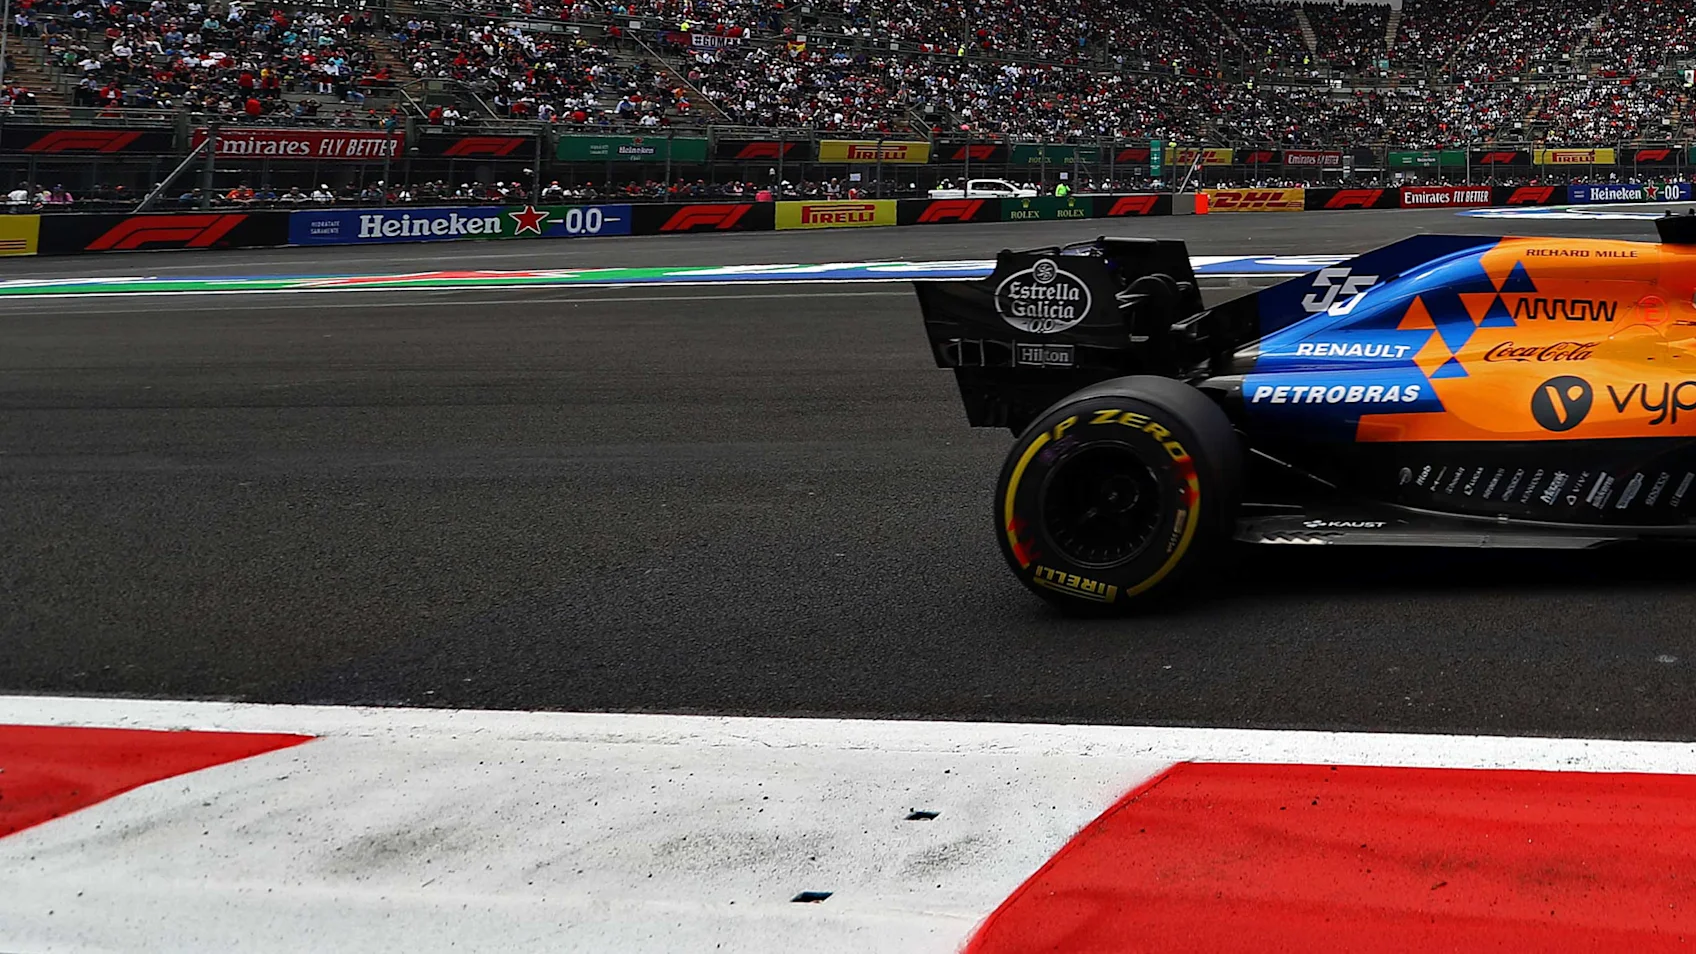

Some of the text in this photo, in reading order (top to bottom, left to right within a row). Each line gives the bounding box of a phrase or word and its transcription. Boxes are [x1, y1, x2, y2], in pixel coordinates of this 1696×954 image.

[318, 139, 345, 155] FLY
[346, 139, 398, 156] BETTER
[847, 144, 908, 159] PIRELLI
[1552, 149, 1595, 162] PIRELLI
[1212, 191, 1292, 209] DHL
[1404, 190, 1489, 205] Emirates FLY BETTER
[1590, 187, 1642, 201] Heineken
[801, 204, 876, 224] PIRELLI
[1010, 208, 1085, 219] ROLEX ROLEX
[357, 213, 502, 238] Heineken
[1526, 249, 1639, 258] RICHARD MILLE
[1008, 281, 1080, 300] Estrella
[1301, 267, 1379, 317] 55
[1011, 300, 1075, 319] Galicia
[1514, 298, 1618, 322] ARROW
[1022, 348, 1069, 362] Hilton
[1295, 343, 1410, 358] RENAULT
[1252, 385, 1421, 404] PETROBRAS
[1053, 409, 1193, 463] P ZERO
[1033, 565, 1118, 603] PIRELLI
